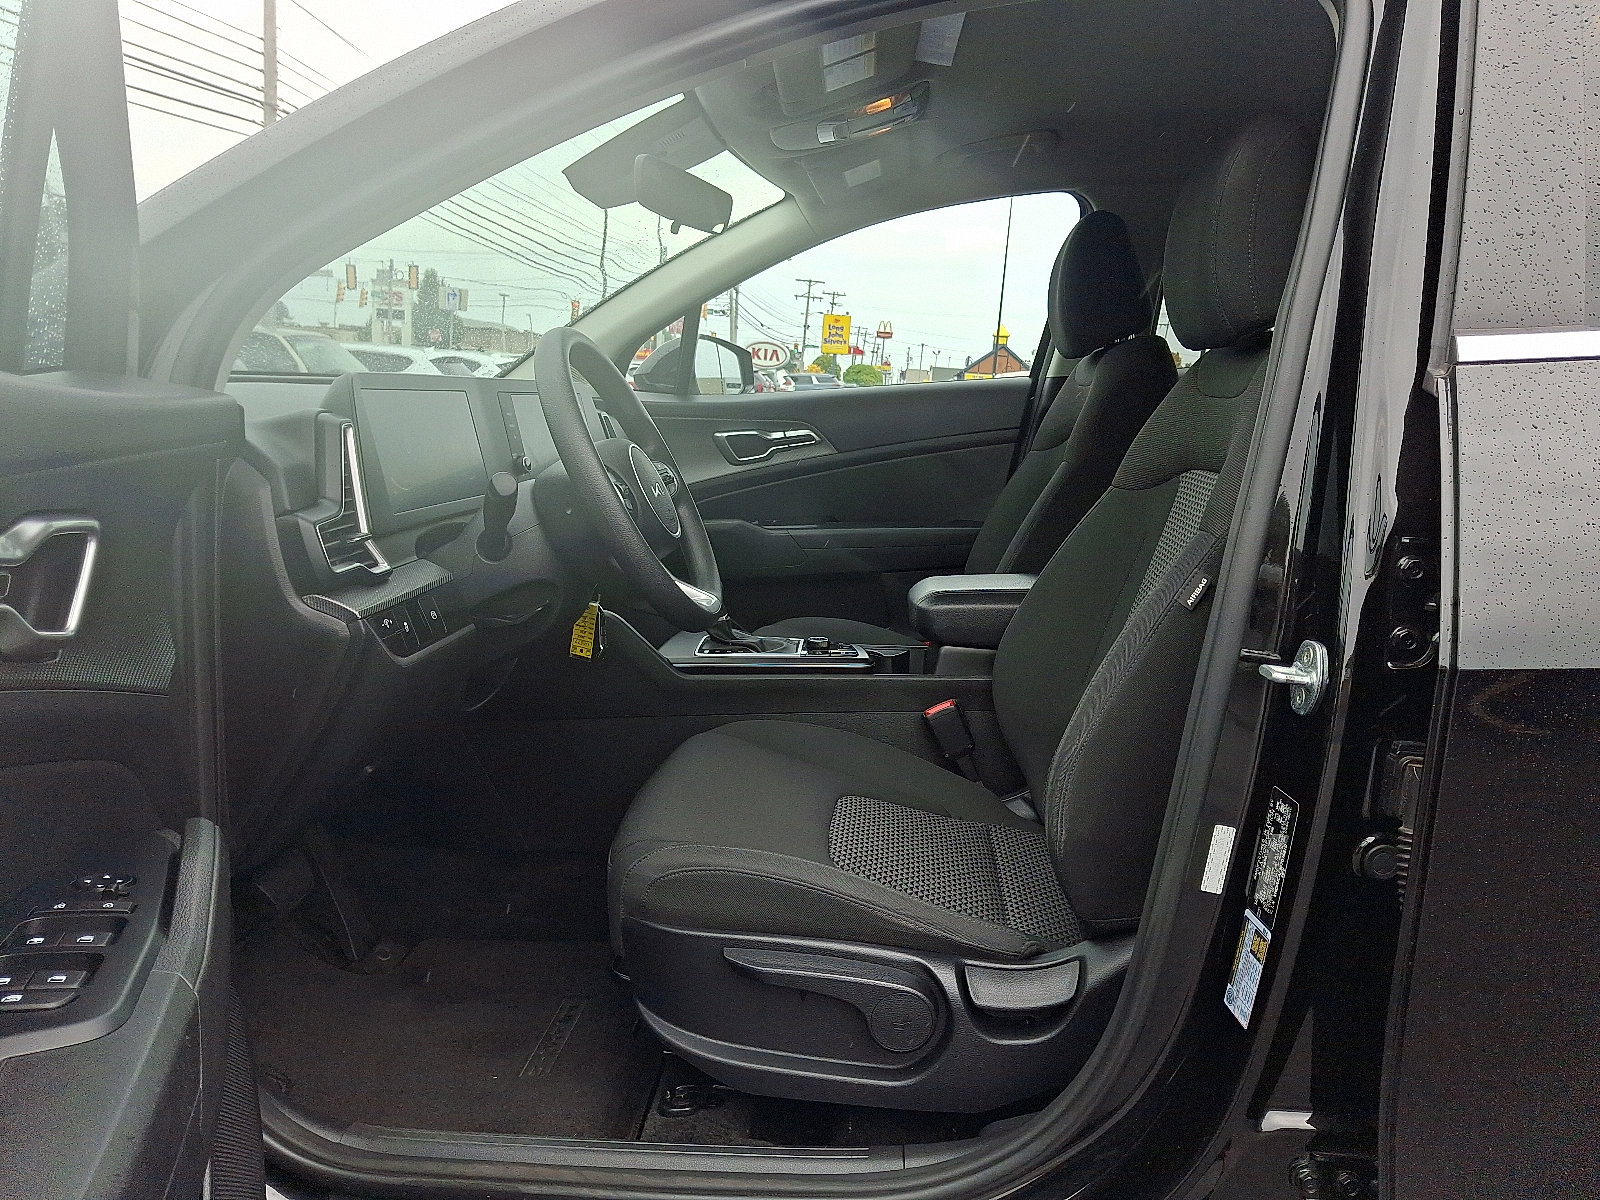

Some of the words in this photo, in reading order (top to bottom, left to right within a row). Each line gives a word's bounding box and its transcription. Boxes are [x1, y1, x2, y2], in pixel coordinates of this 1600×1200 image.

[828, 324, 844, 332] Long
[828, 331, 844, 339] John
[823, 337, 847, 345] Silver's
[751, 347, 780, 362] KIA
[1186, 577, 1208, 606] AIRBAG
